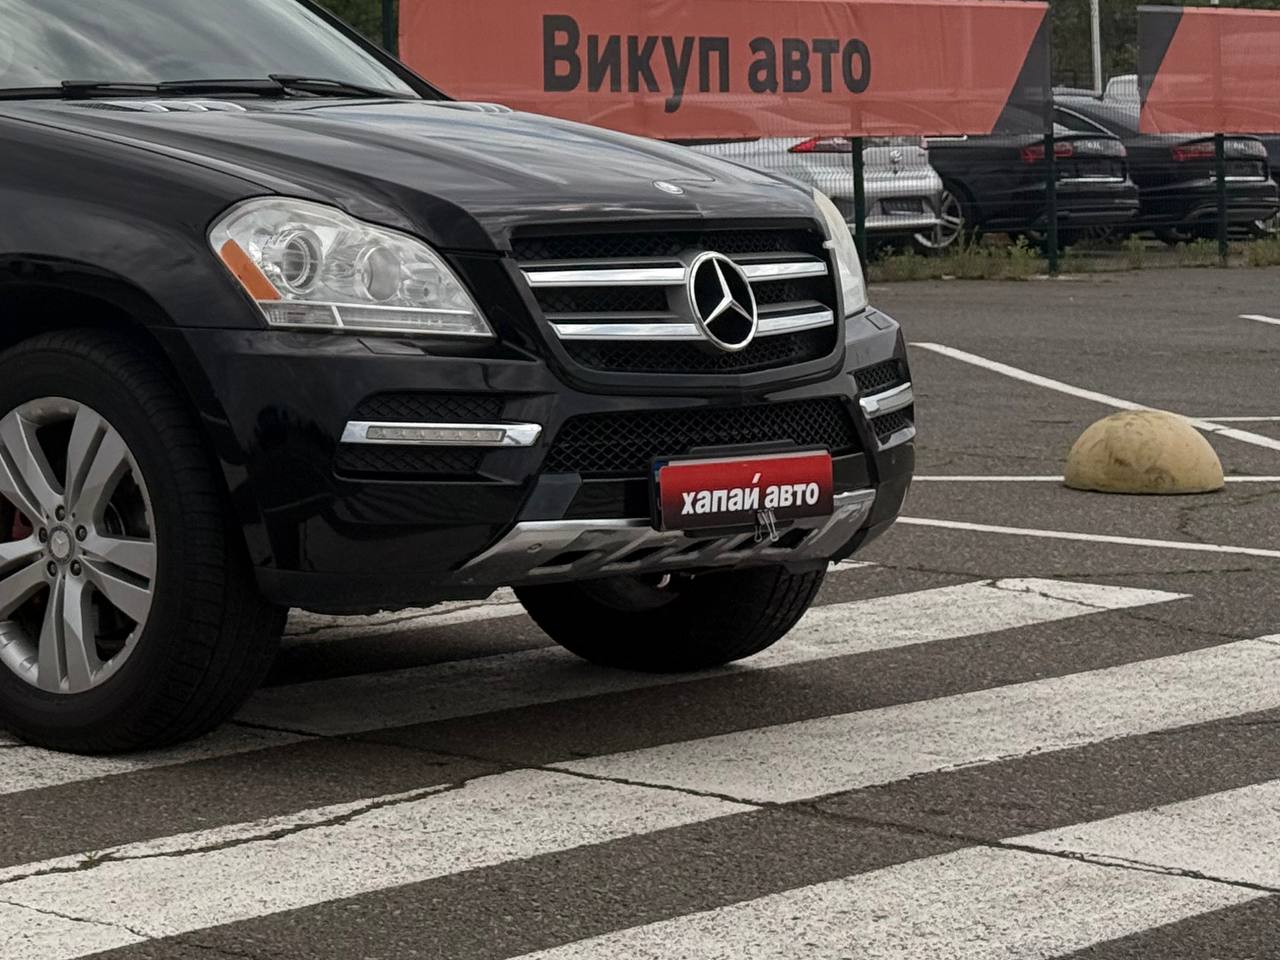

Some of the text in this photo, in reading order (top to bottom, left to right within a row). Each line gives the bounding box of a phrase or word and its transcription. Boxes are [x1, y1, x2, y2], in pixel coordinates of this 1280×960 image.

[542, 14, 872, 114] Викуп авто
[764, 482, 820, 509] авто
